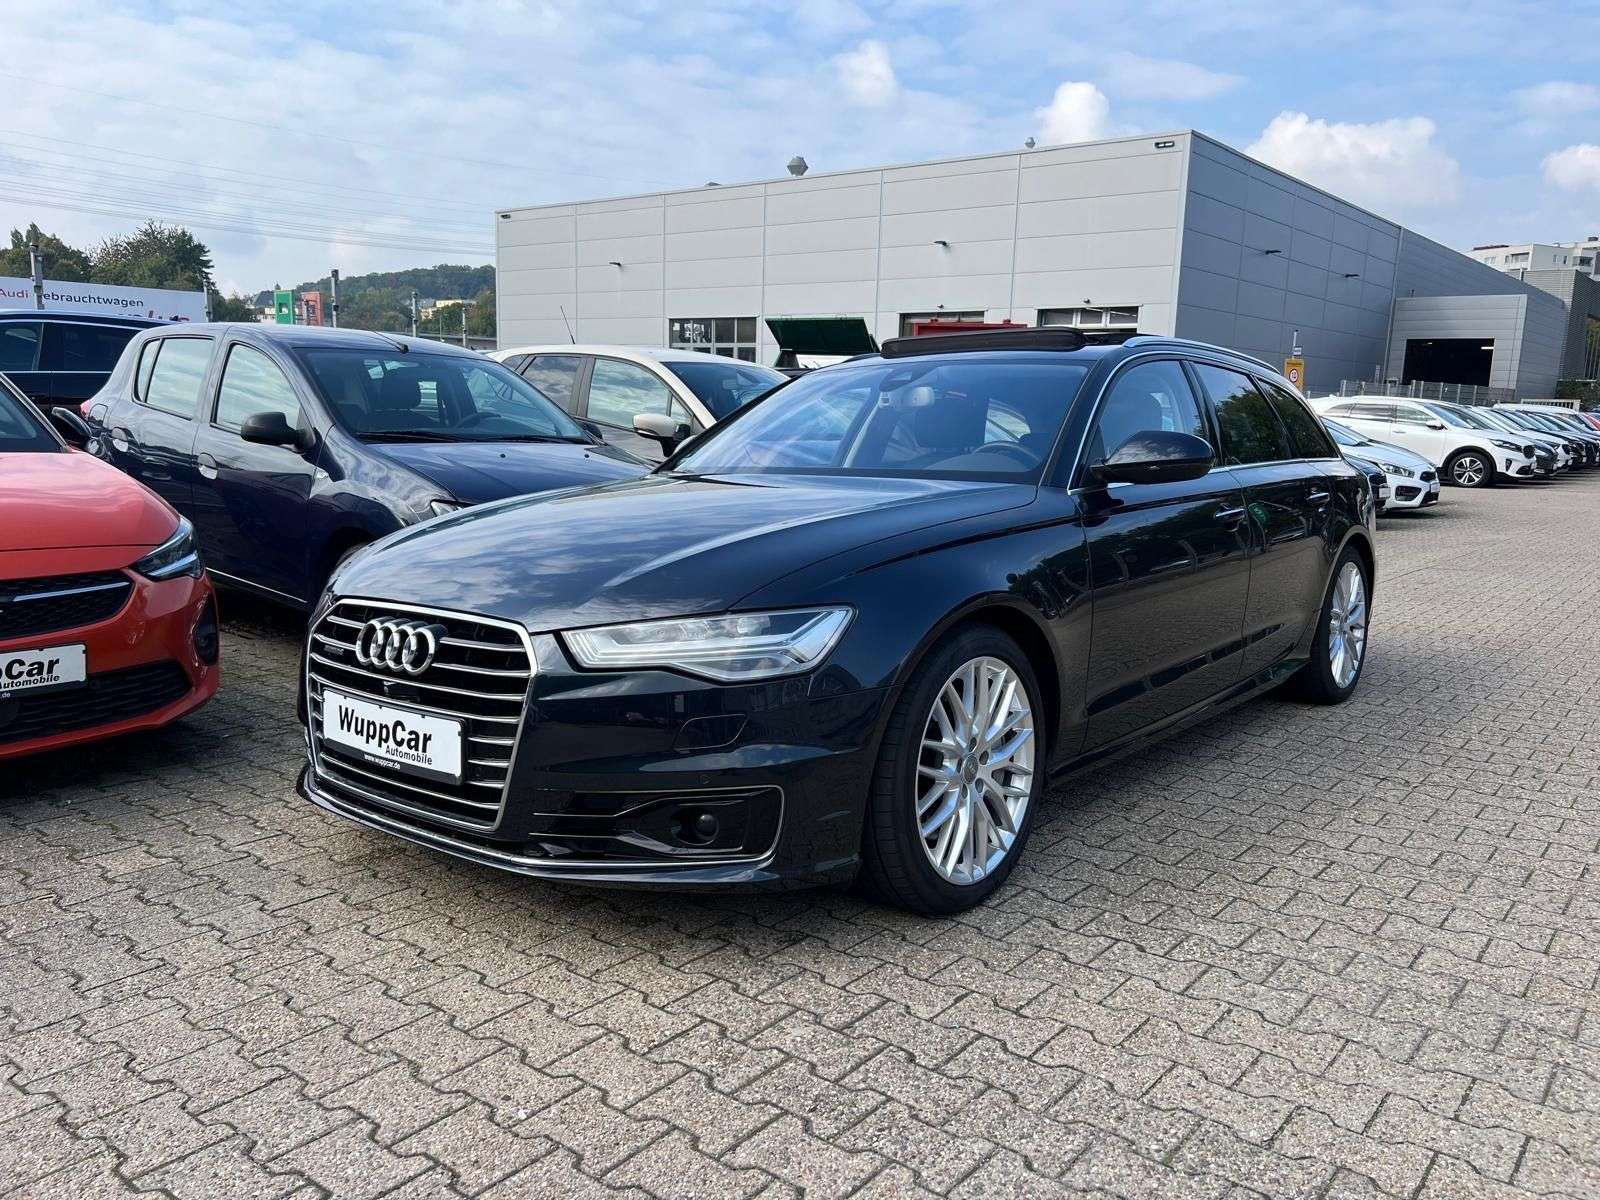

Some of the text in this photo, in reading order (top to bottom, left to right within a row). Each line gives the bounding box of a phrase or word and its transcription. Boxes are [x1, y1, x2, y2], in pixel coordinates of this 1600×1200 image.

[0, 288, 144, 308] Audi ebrauchtwagen
[0, 658, 60, 680] Car
[338, 704, 432, 753] WuppCar
[385, 744, 433, 766] Automobile
